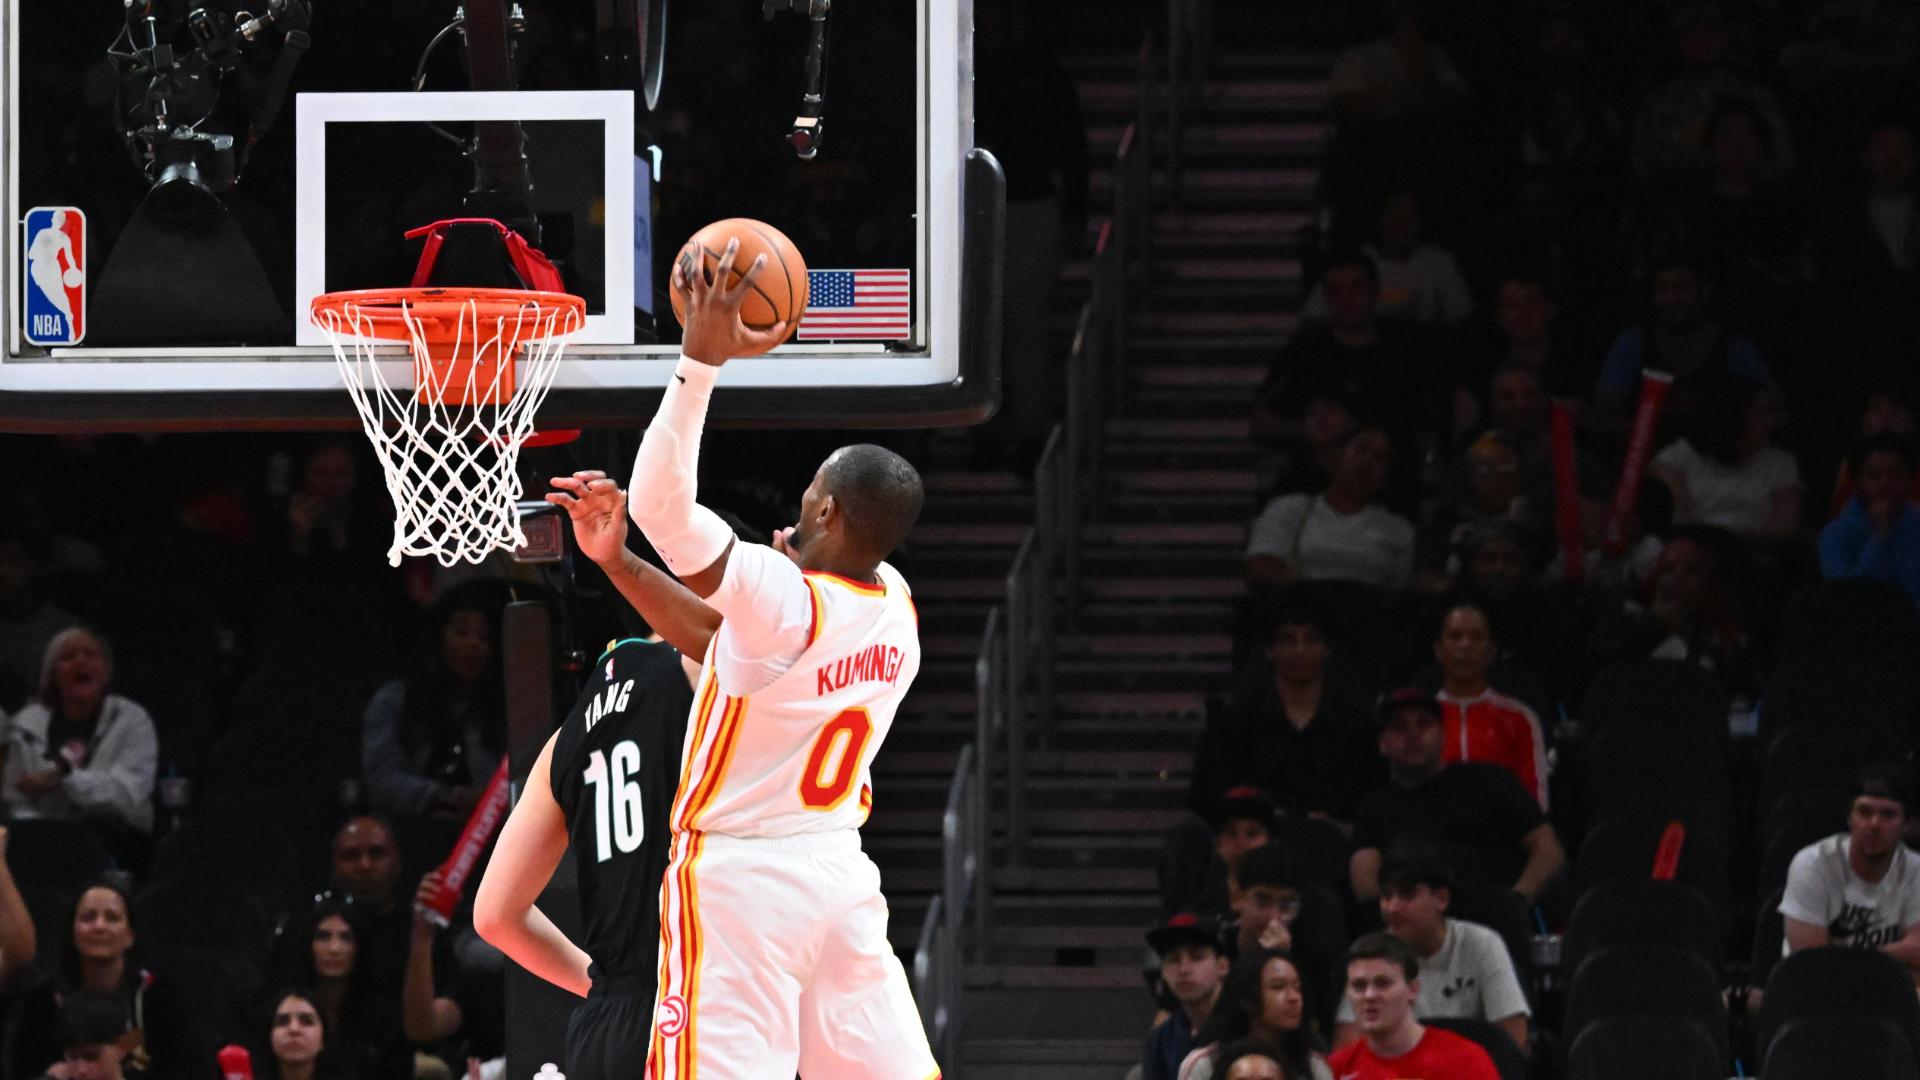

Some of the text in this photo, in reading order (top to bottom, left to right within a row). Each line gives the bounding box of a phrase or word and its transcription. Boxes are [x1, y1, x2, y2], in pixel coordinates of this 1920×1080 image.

[33, 314, 62, 336] NBA
[584, 678, 635, 733] YANG
[797, 706, 874, 811] 0
[583, 739, 644, 862] 16
